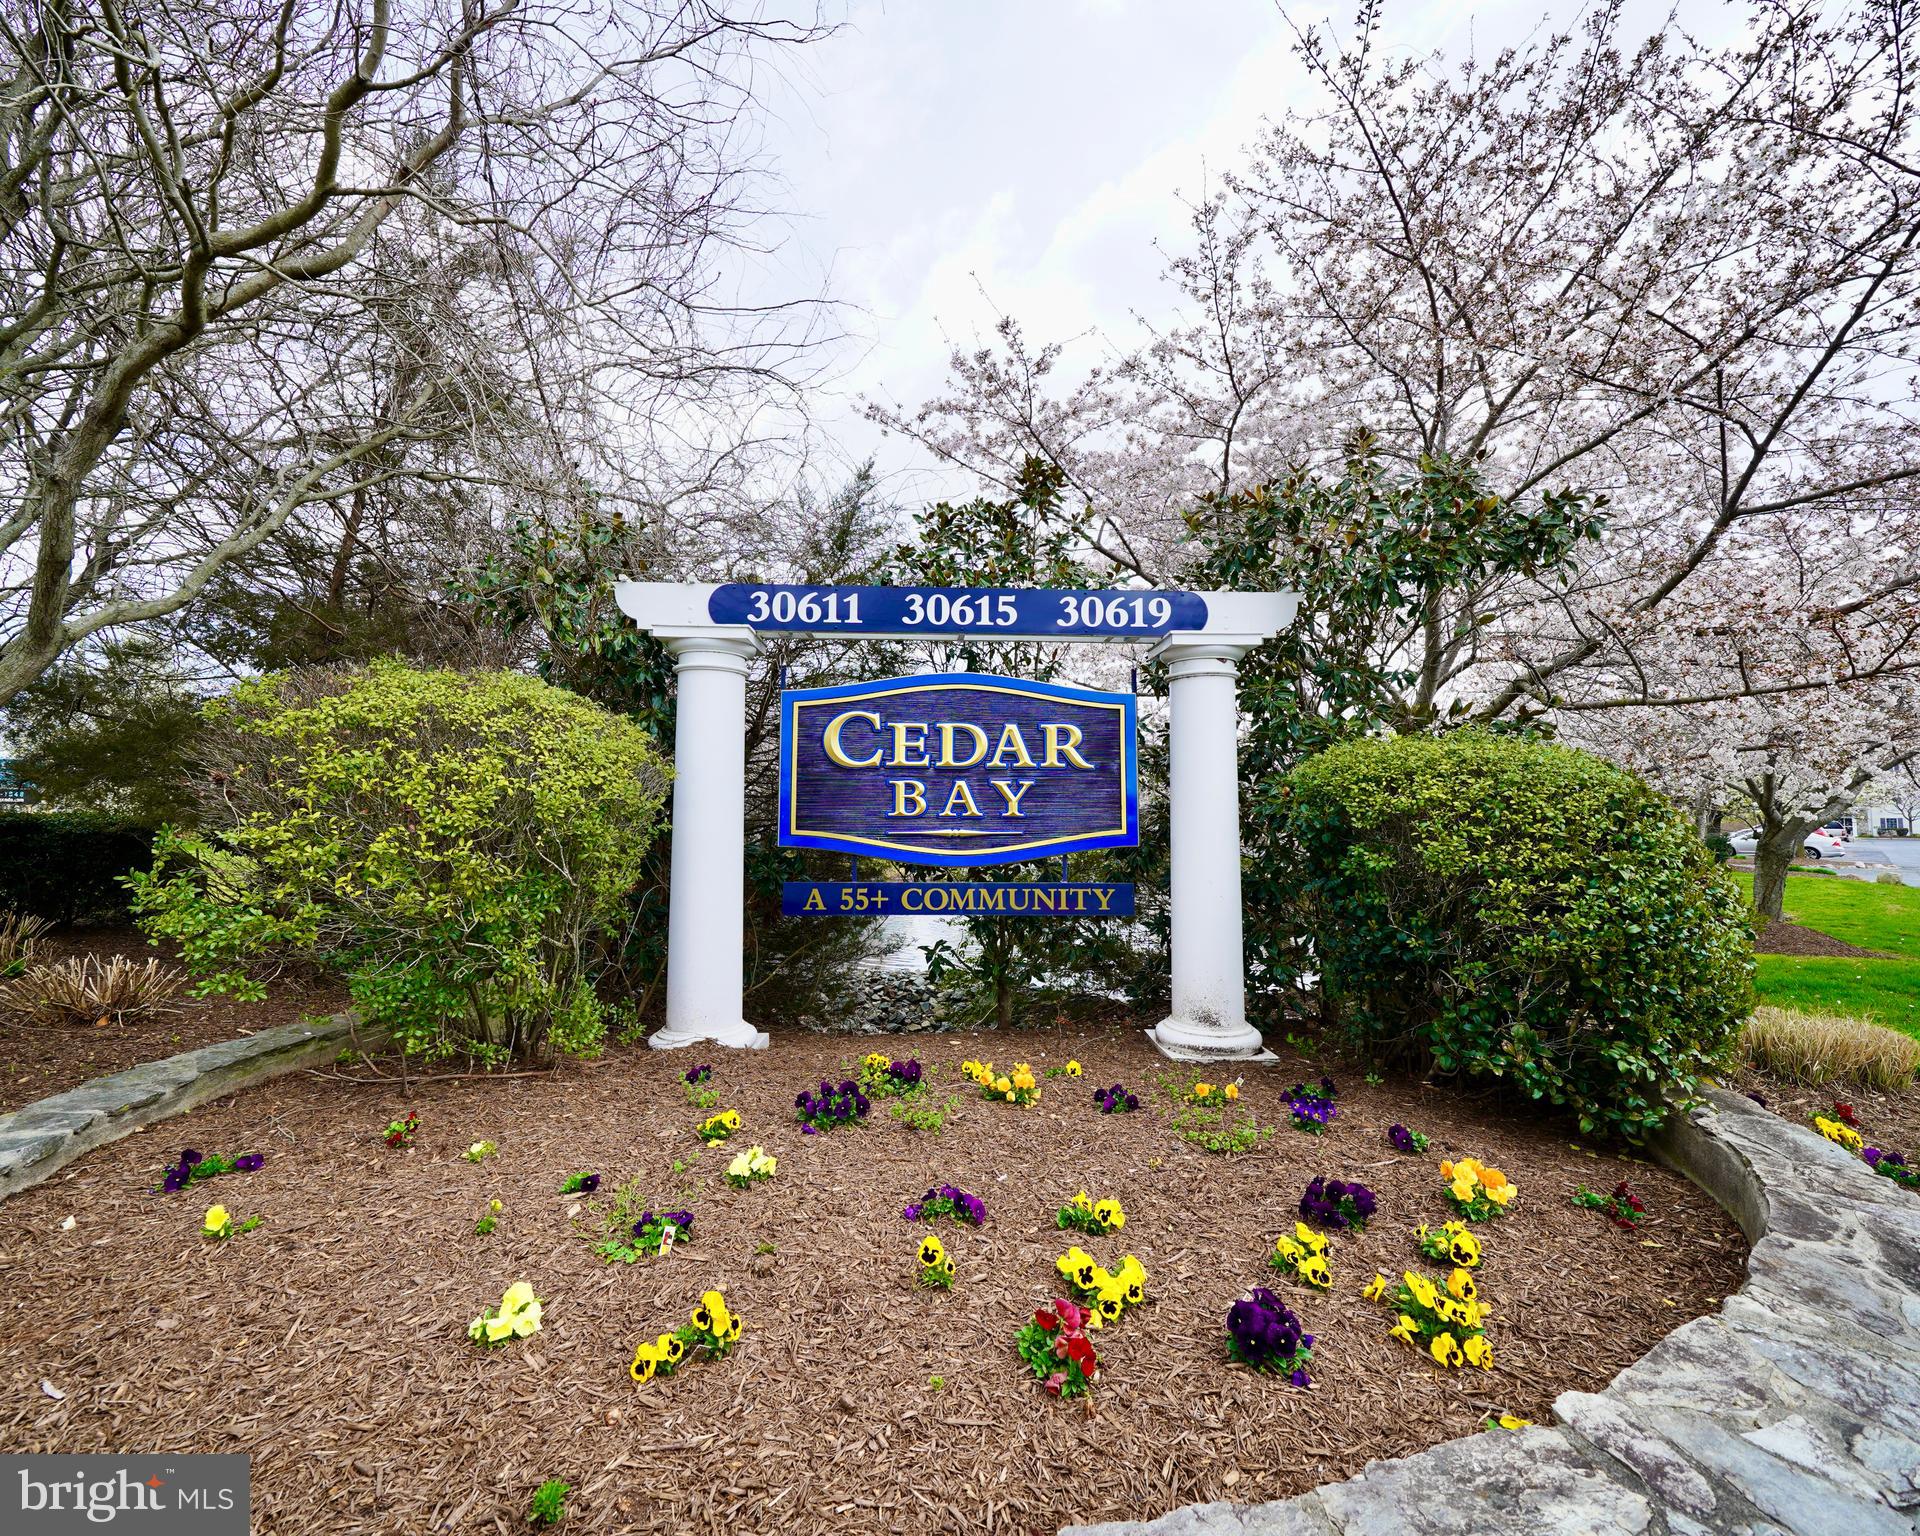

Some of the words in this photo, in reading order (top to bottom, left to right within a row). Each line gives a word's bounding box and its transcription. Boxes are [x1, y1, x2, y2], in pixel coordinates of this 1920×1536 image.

[747, 591, 863, 623] 30611
[901, 593, 1018, 626] 30615
[1056, 596, 1172, 628] 30619
[823, 711, 1095, 770] CEDAR
[888, 780, 1035, 818] BAY
[803, 888, 825, 911] A
[840, 888, 888, 911] 55+
[901, 888, 1115, 911] COMMUNITY
